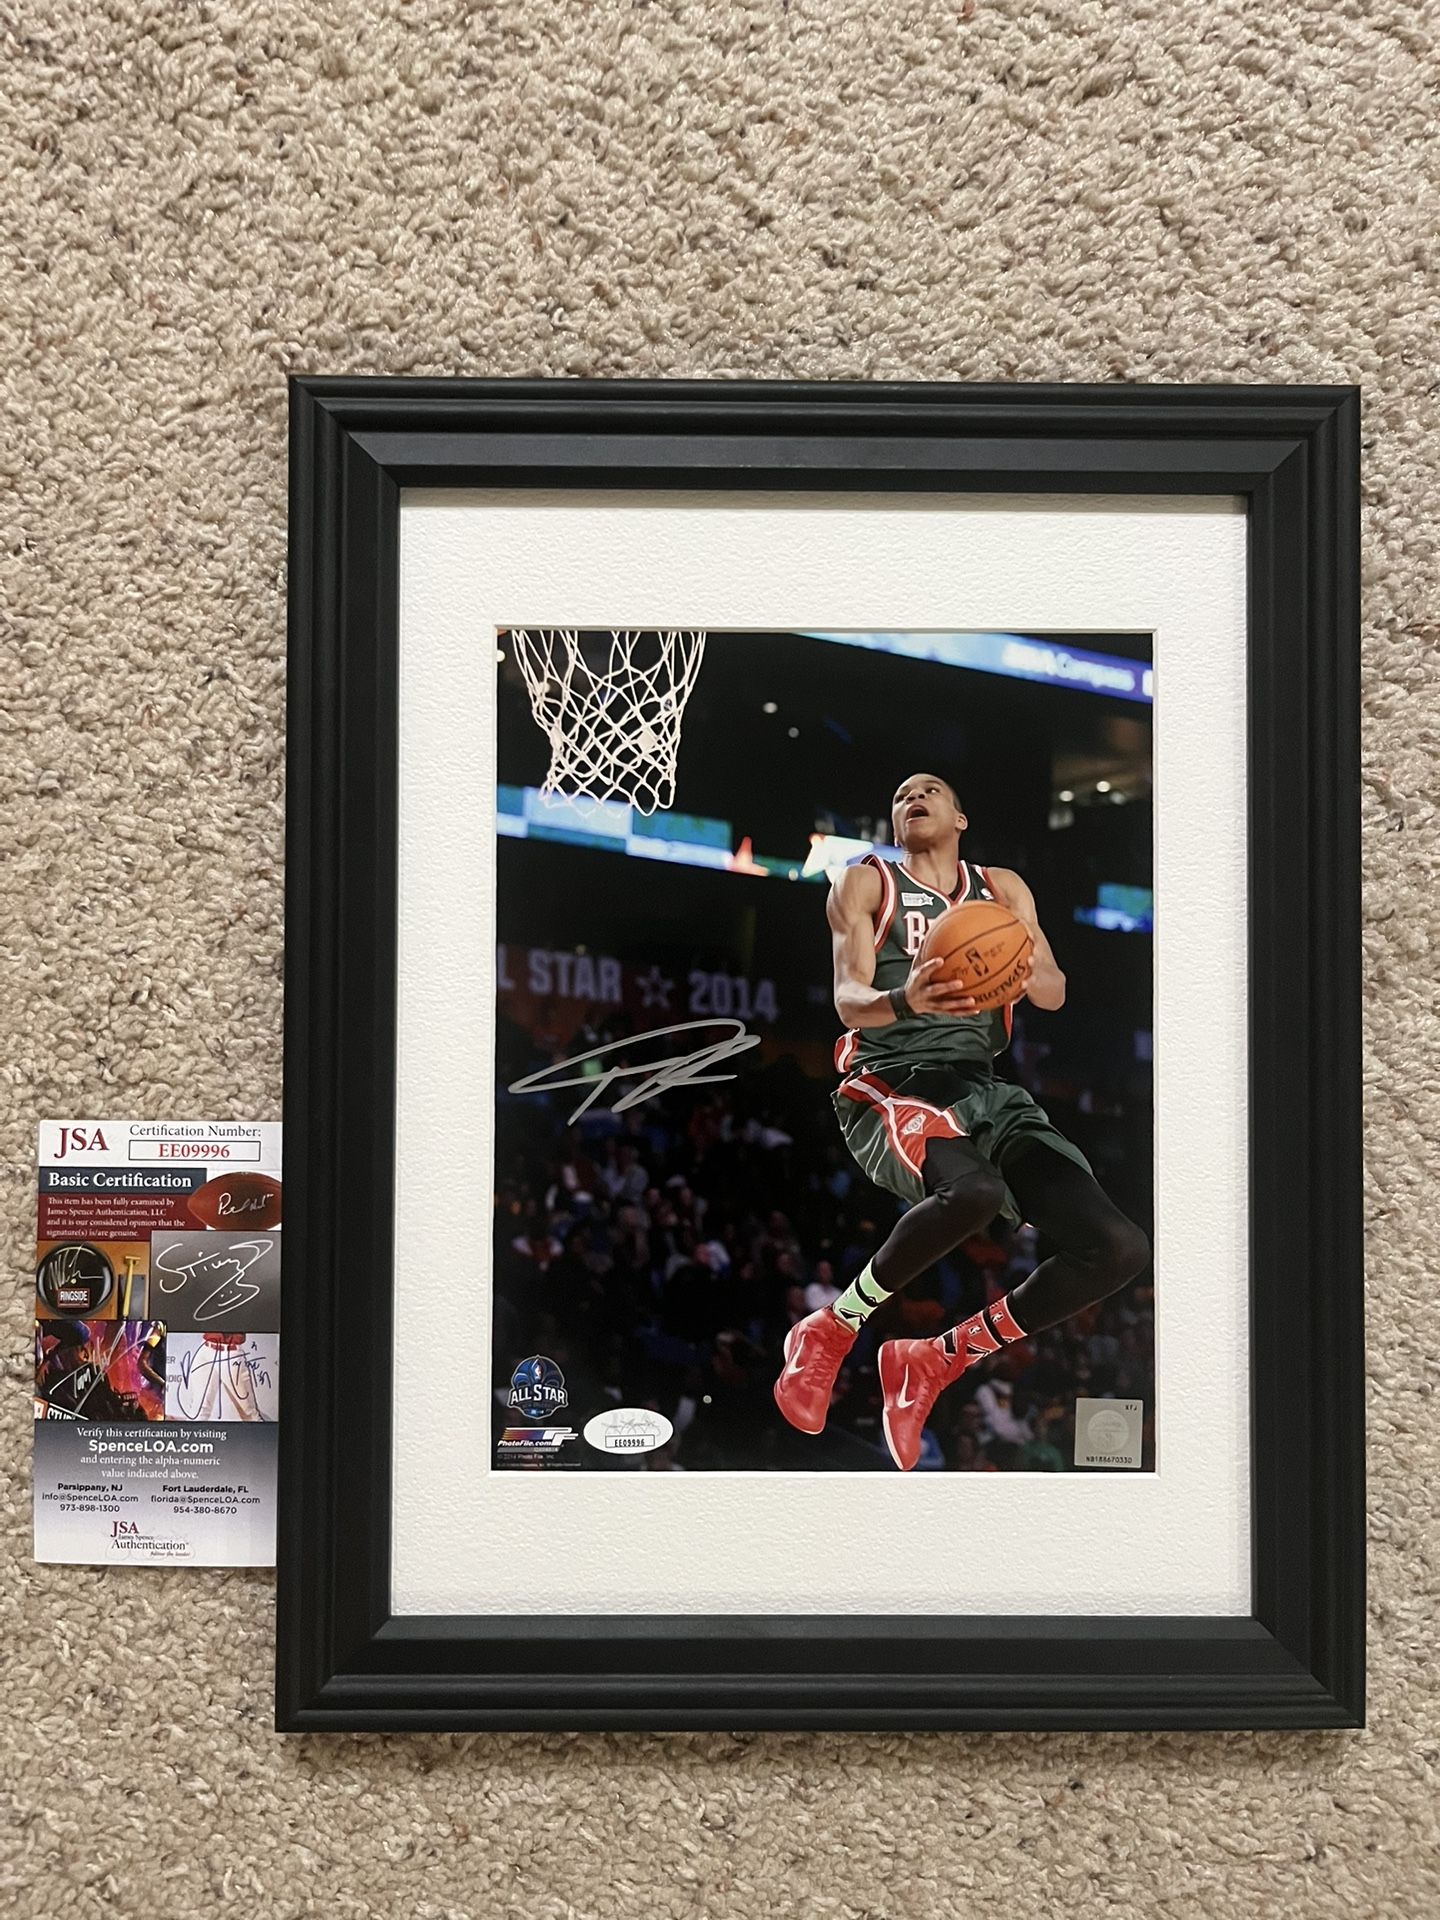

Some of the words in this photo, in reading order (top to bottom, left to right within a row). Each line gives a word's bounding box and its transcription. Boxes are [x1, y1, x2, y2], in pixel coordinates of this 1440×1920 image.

[528, 950, 622, 1001] STAR
[688, 970, 778, 1022] 2014
[130, 1124, 206, 1137] Certification
[208, 1125, 262, 1137] Number:
[54, 1127, 109, 1159] JSA
[158, 1143, 231, 1158] EE09996
[48, 1172, 89, 1187] Basic
[93, 1172, 192, 1188] Certification
[48, 1197, 63, 1205] This
[113, 1198, 130, 1207] fully
[131, 1198, 165, 1206] examined
[166, 1198, 175, 1207] by
[47, 1208, 68, 1216] James
[69, 1208, 94, 1217] Spence
[46, 1218, 60, 1226] and
[61, 1218, 67, 1226] it
[89, 1219, 128, 1227] considered
[129, 1219, 157, 1228] opinion
[158, 1219, 173, 1227] that
[173, 1219, 186, 1227] the
[510, 1386, 532, 1405] ALL
[533, 1383, 565, 1405] STAR
[77, 1427, 104, 1439] Verify
[105, 1428, 123, 1438] this
[124, 1428, 178, 1439] certification
[180, 1428, 192, 1441] by
[193, 1429, 227, 1441] visiting
[88, 1440, 214, 1454] SpenceLOA.com
[614, 1438, 645, 1448] EE09996
[80, 1454, 98, 1464] and
[99, 1455, 137, 1467] entering
[139, 1455, 153, 1465] the
[155, 1455, 221, 1467] alpha-numeric
[101, 1468, 126, 1479] value
[127, 1468, 169, 1479] indicated
[170, 1469, 199, 1479] above.
[57, 1483, 109, 1493] Parsippany,
[110, 1484, 123, 1492] NJ
[162, 1485, 182, 1493] Fort
[183, 1485, 236, 1495] Lauderdale,
[237, 1486, 249, 1494] FL
[41, 1492, 139, 1504] info@SpenceLOA.com
[151, 1495, 261, 1506] florida@SpenceLOA.com
[59, 1504, 120, 1513] 973-898-1300
[173, 1506, 238, 1515] 954-380-8670
[110, 1521, 140, 1538] JSA
